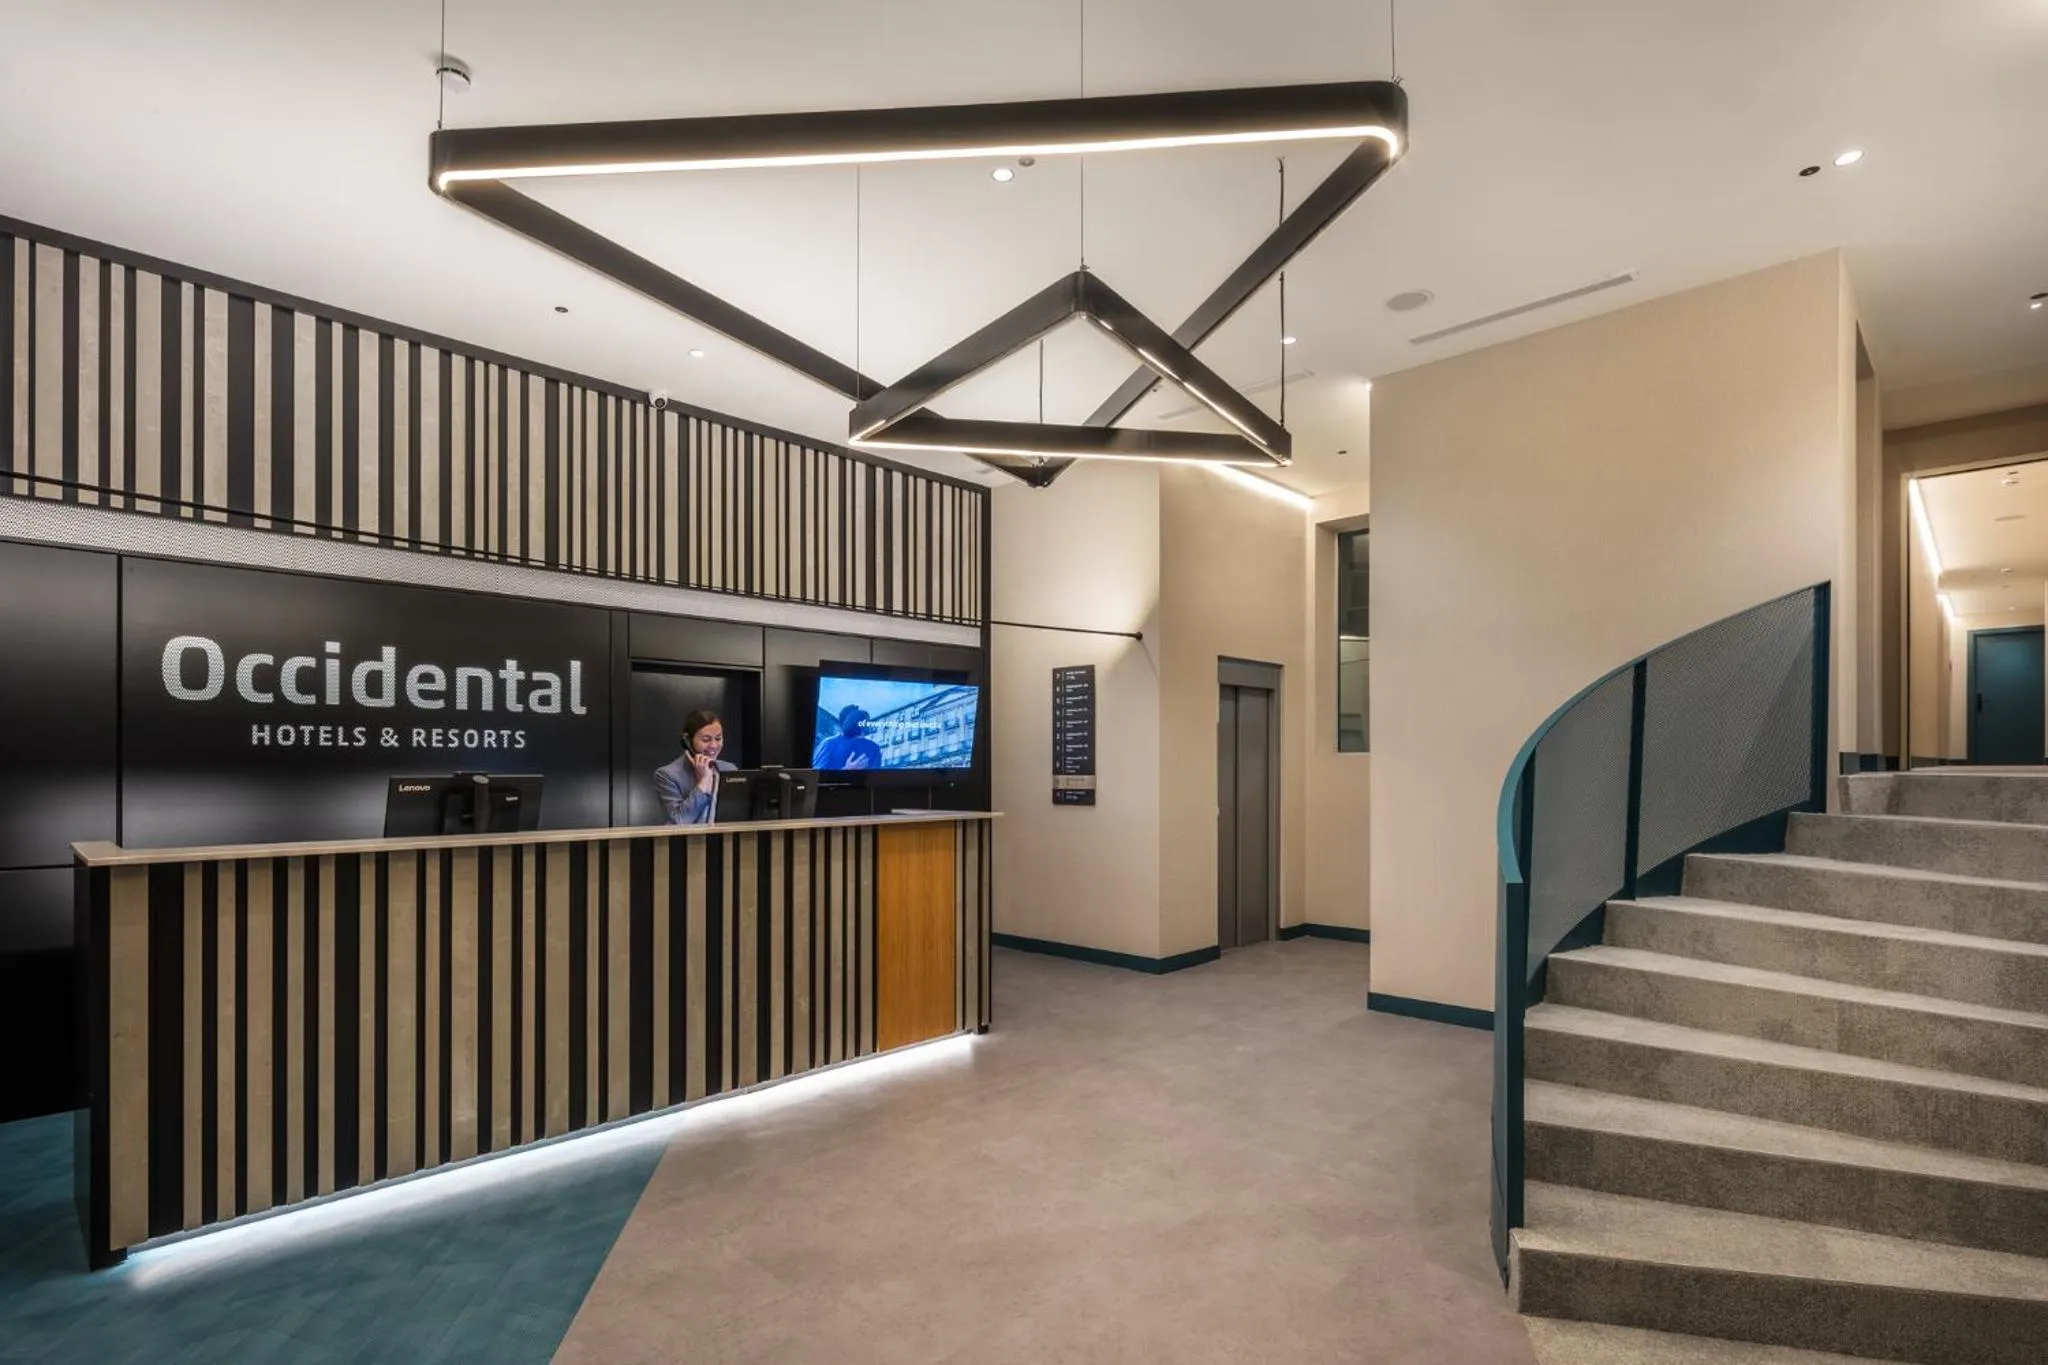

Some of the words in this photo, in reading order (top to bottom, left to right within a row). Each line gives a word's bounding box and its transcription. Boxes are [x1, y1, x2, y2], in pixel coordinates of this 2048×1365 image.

[162, 636, 587, 714] Occidental
[252, 724, 366, 746] HOTELS
[380, 727, 399, 747] &
[412, 728, 526, 748] RESORTS
[398, 784, 431, 792] Lenovo
